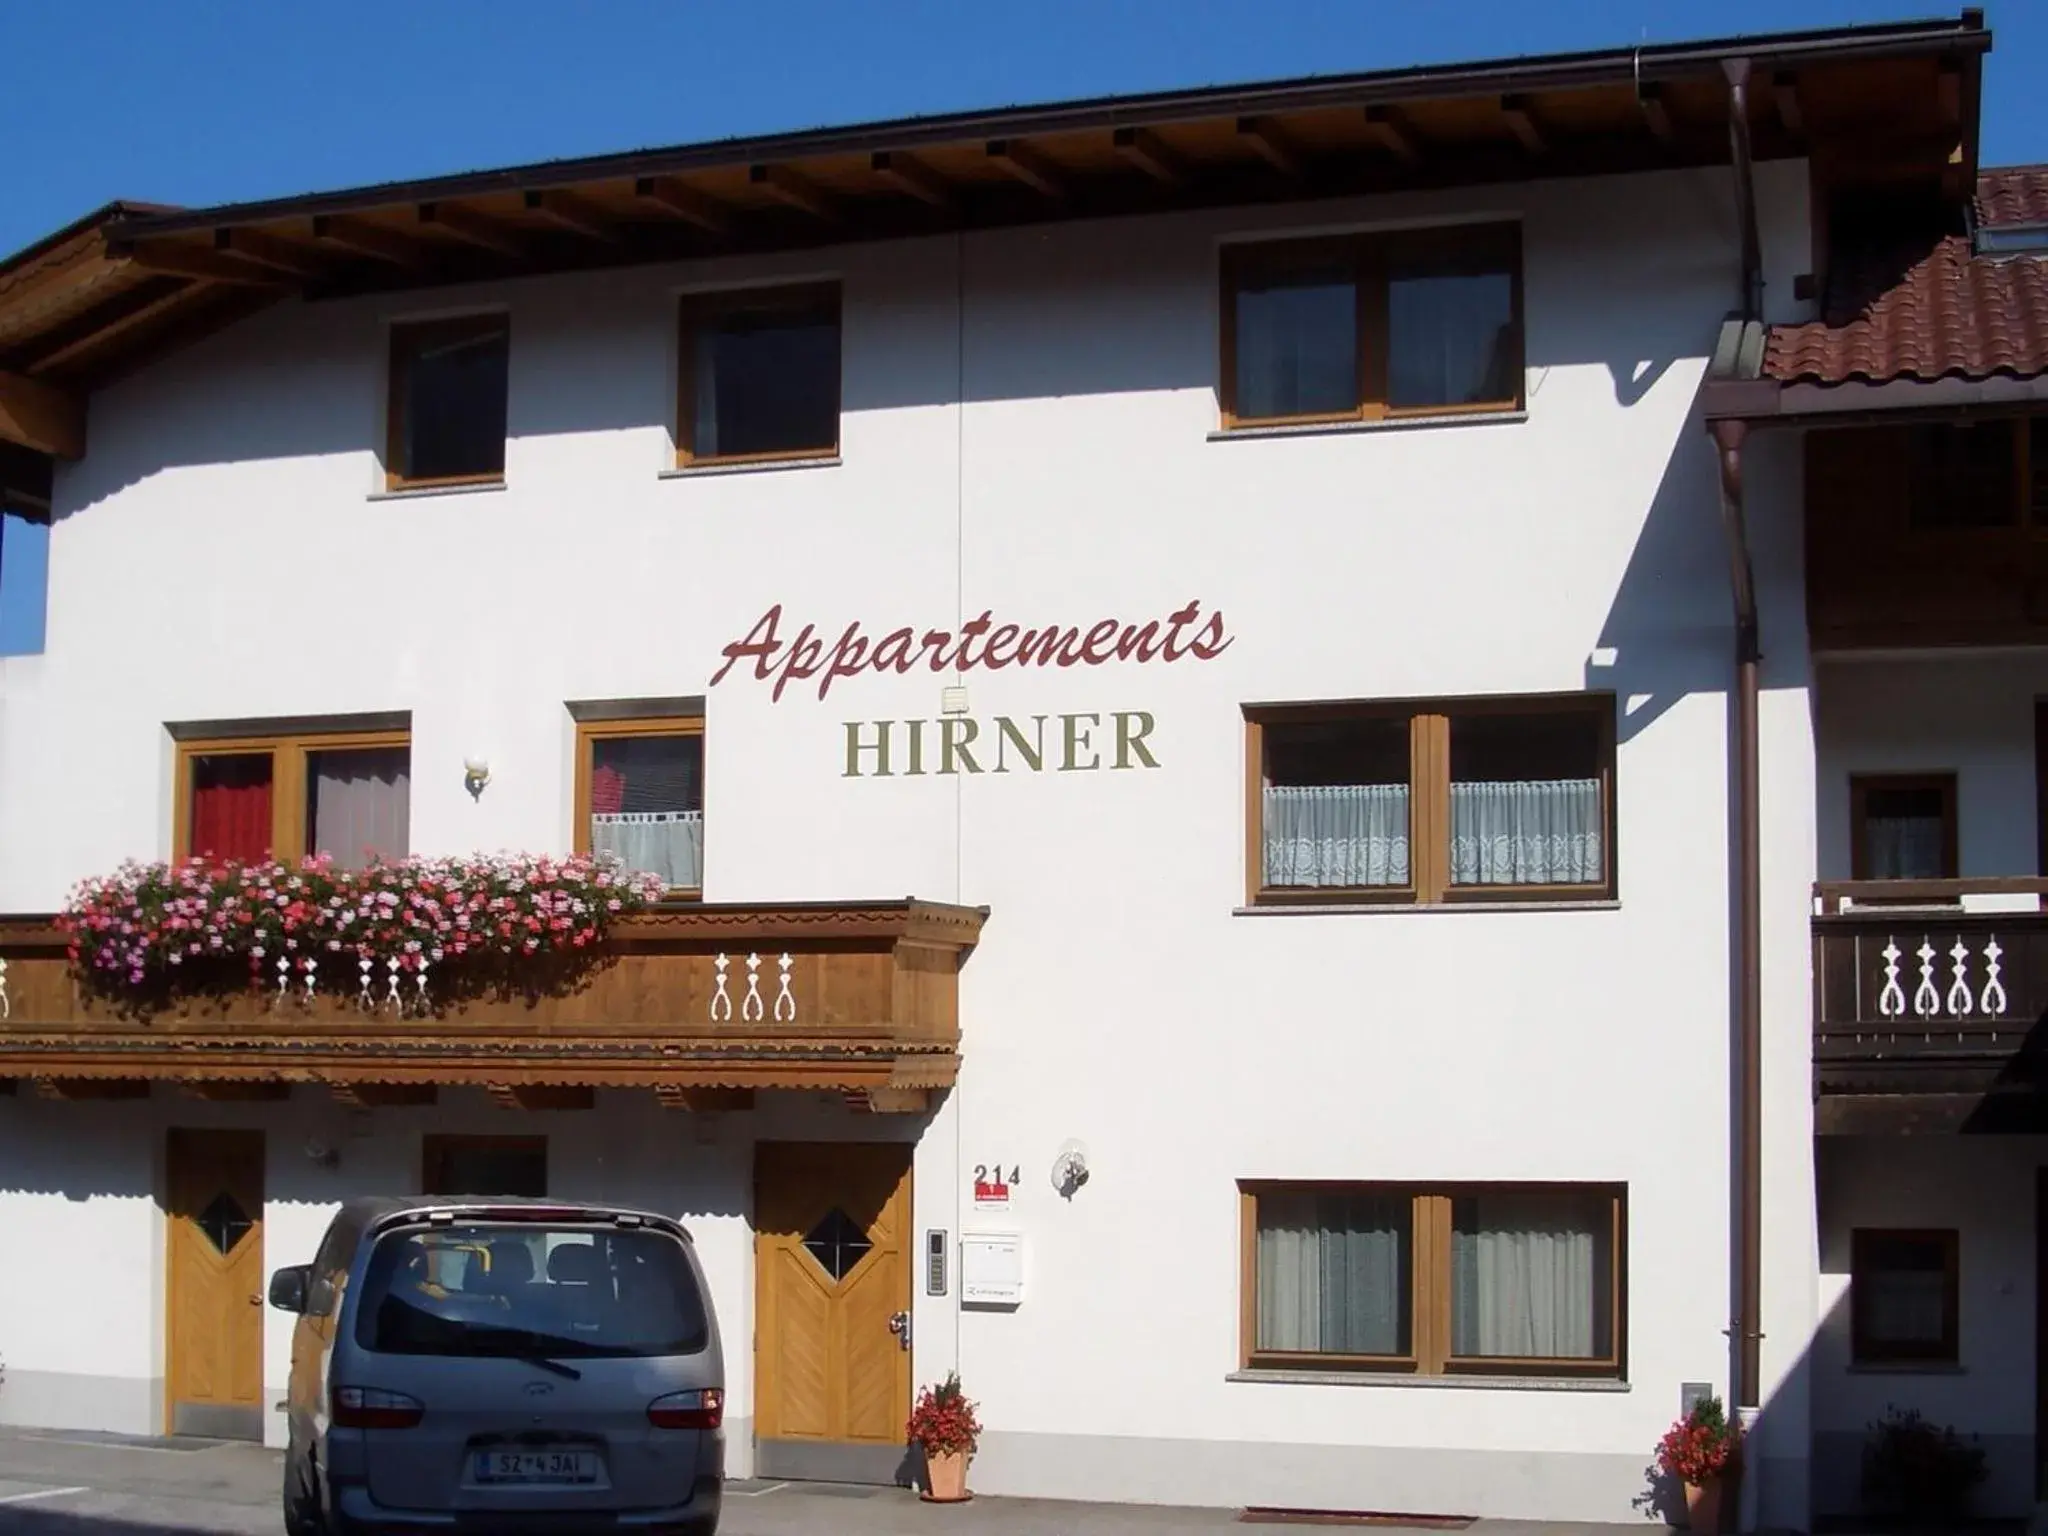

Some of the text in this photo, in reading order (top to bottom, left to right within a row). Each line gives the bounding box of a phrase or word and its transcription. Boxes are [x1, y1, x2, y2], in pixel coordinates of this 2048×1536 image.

[709, 600, 1234, 702] Appartements
[842, 711, 1161, 777] HIRNER
[974, 1164, 1020, 1185] 214
